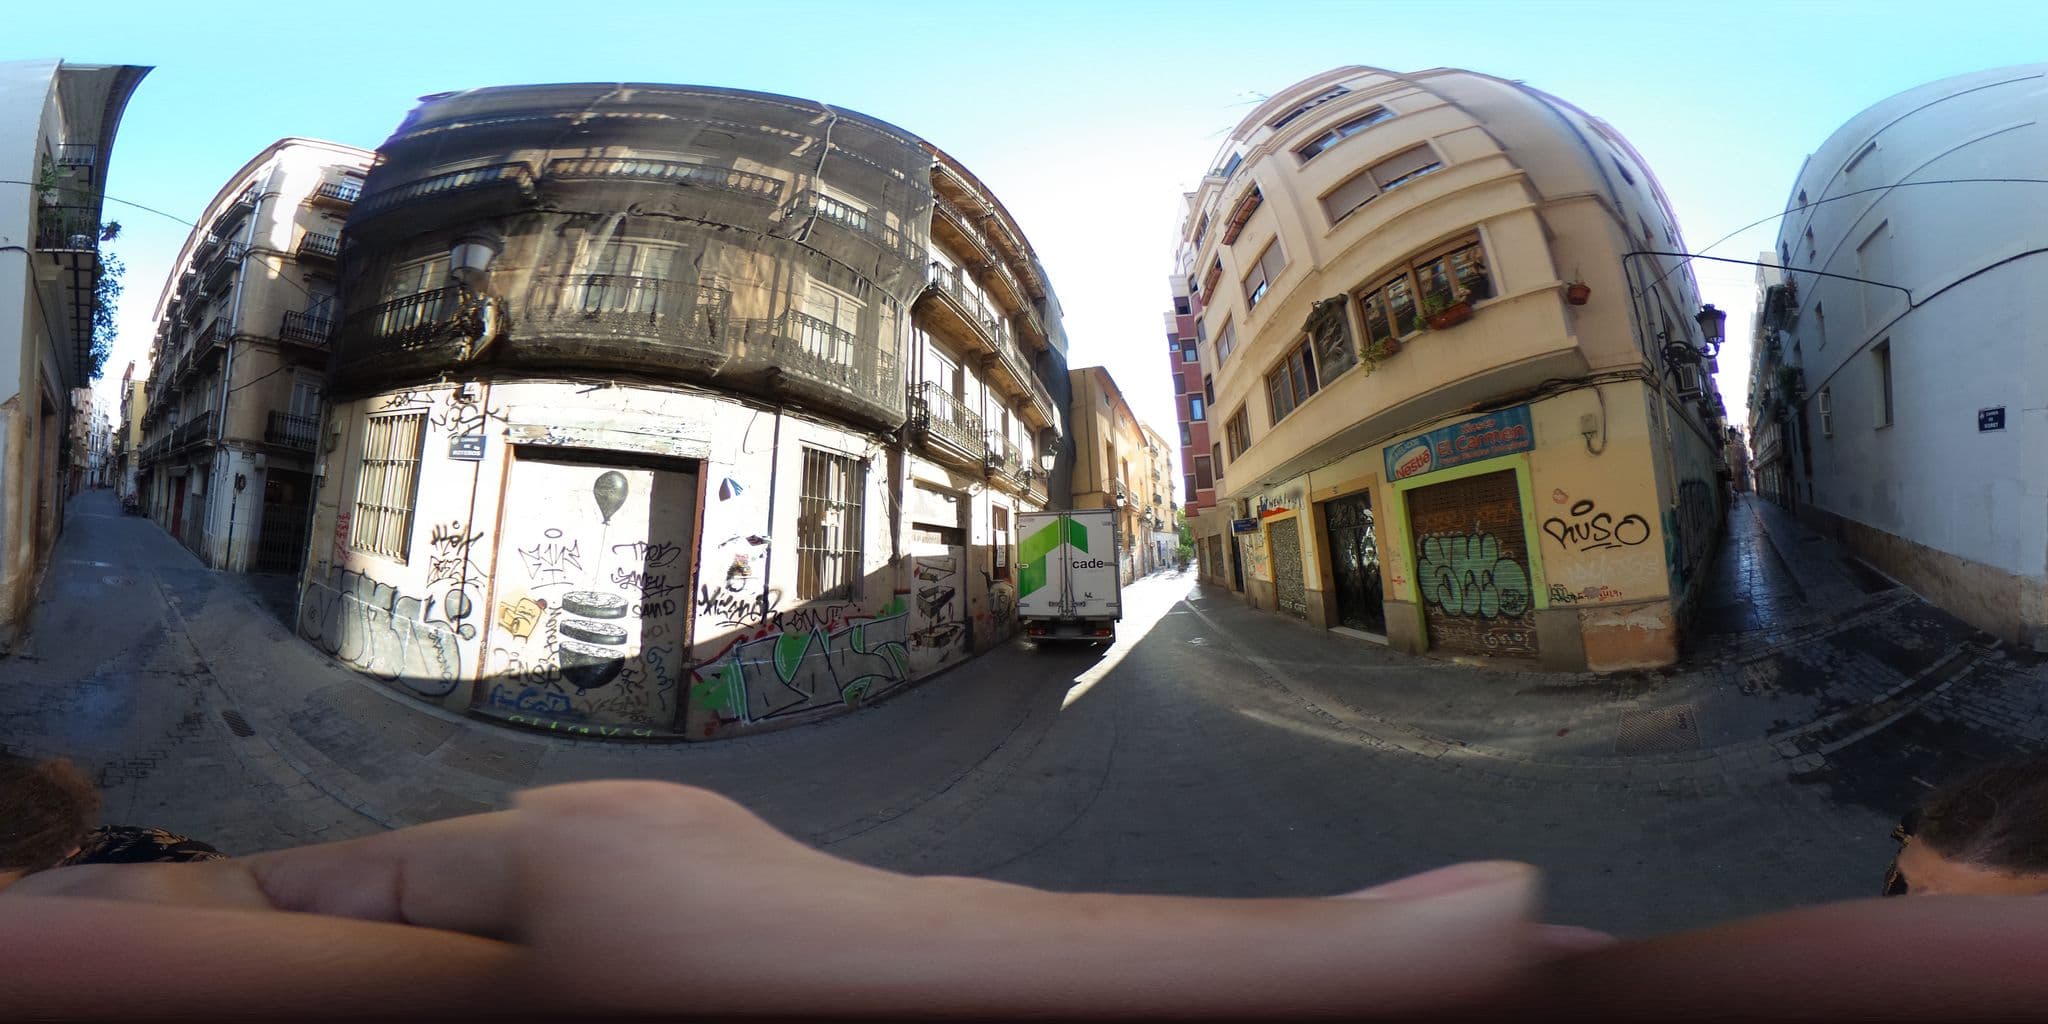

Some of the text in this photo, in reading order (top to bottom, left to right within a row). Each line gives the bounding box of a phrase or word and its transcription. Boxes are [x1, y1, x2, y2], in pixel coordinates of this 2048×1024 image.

[1455, 424, 1527, 451] Carmen
[1396, 448, 1431, 478] Nestlé
[1072, 558, 1104, 569] cade
